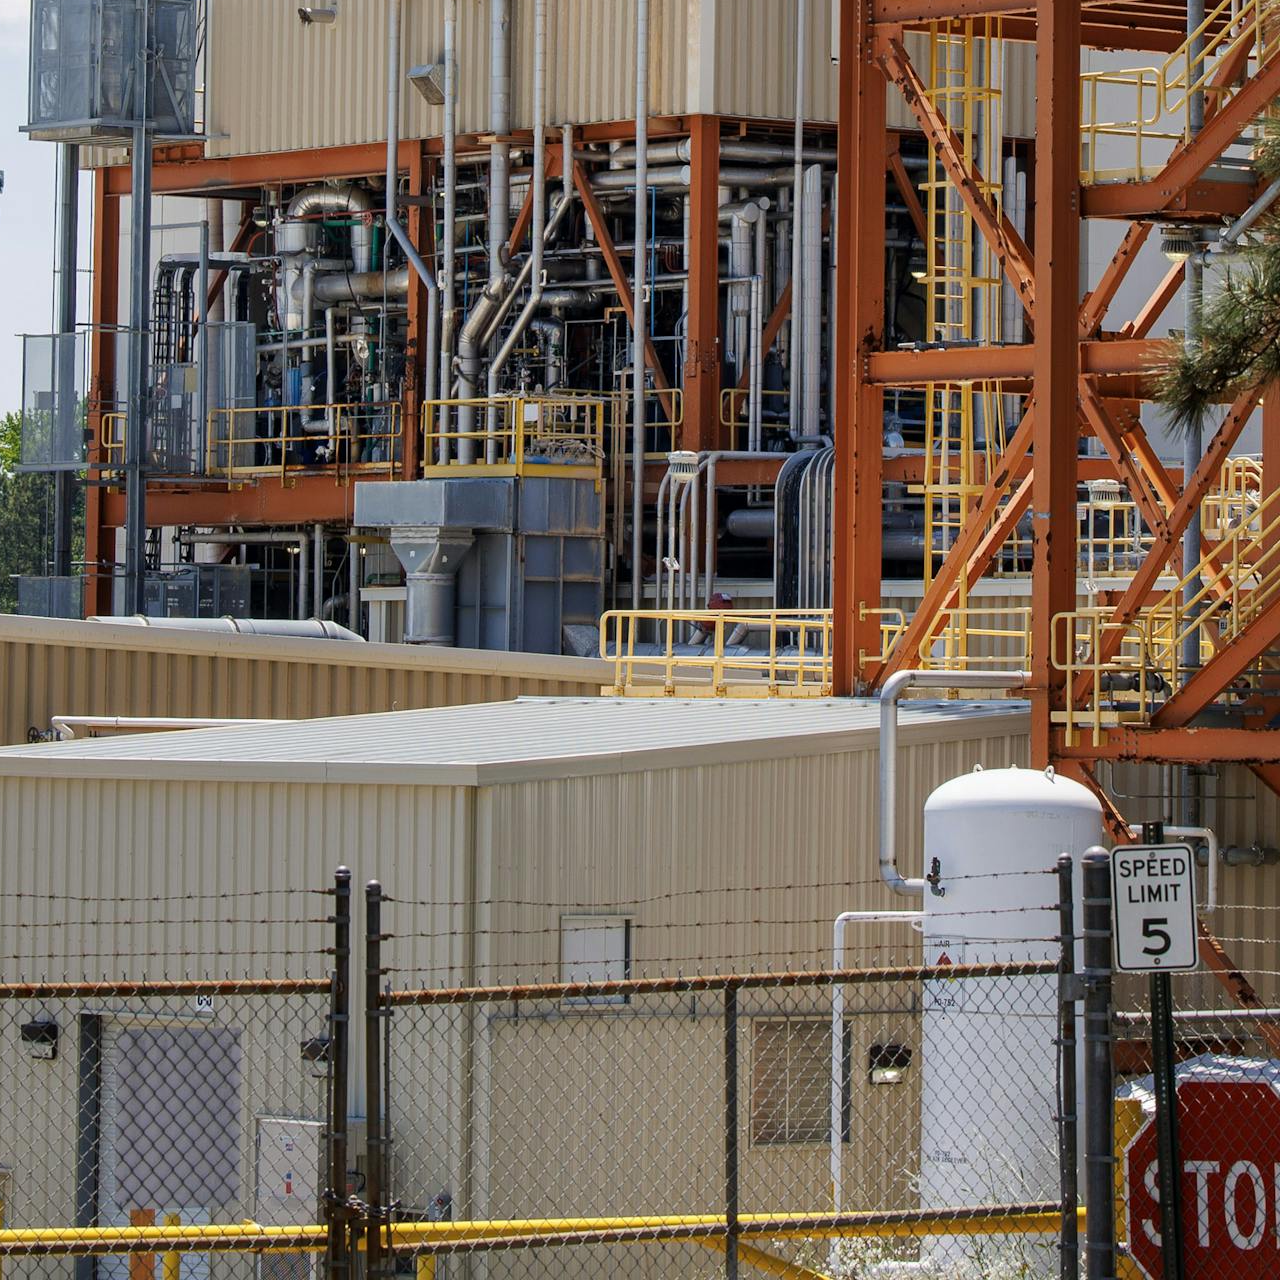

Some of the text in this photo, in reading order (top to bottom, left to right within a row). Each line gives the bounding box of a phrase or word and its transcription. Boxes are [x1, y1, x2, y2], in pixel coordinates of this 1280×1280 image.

[1119, 858, 1186, 878] SPEED
[1128, 883, 1181, 904] LIMIT
[1142, 918, 1172, 956] 5
